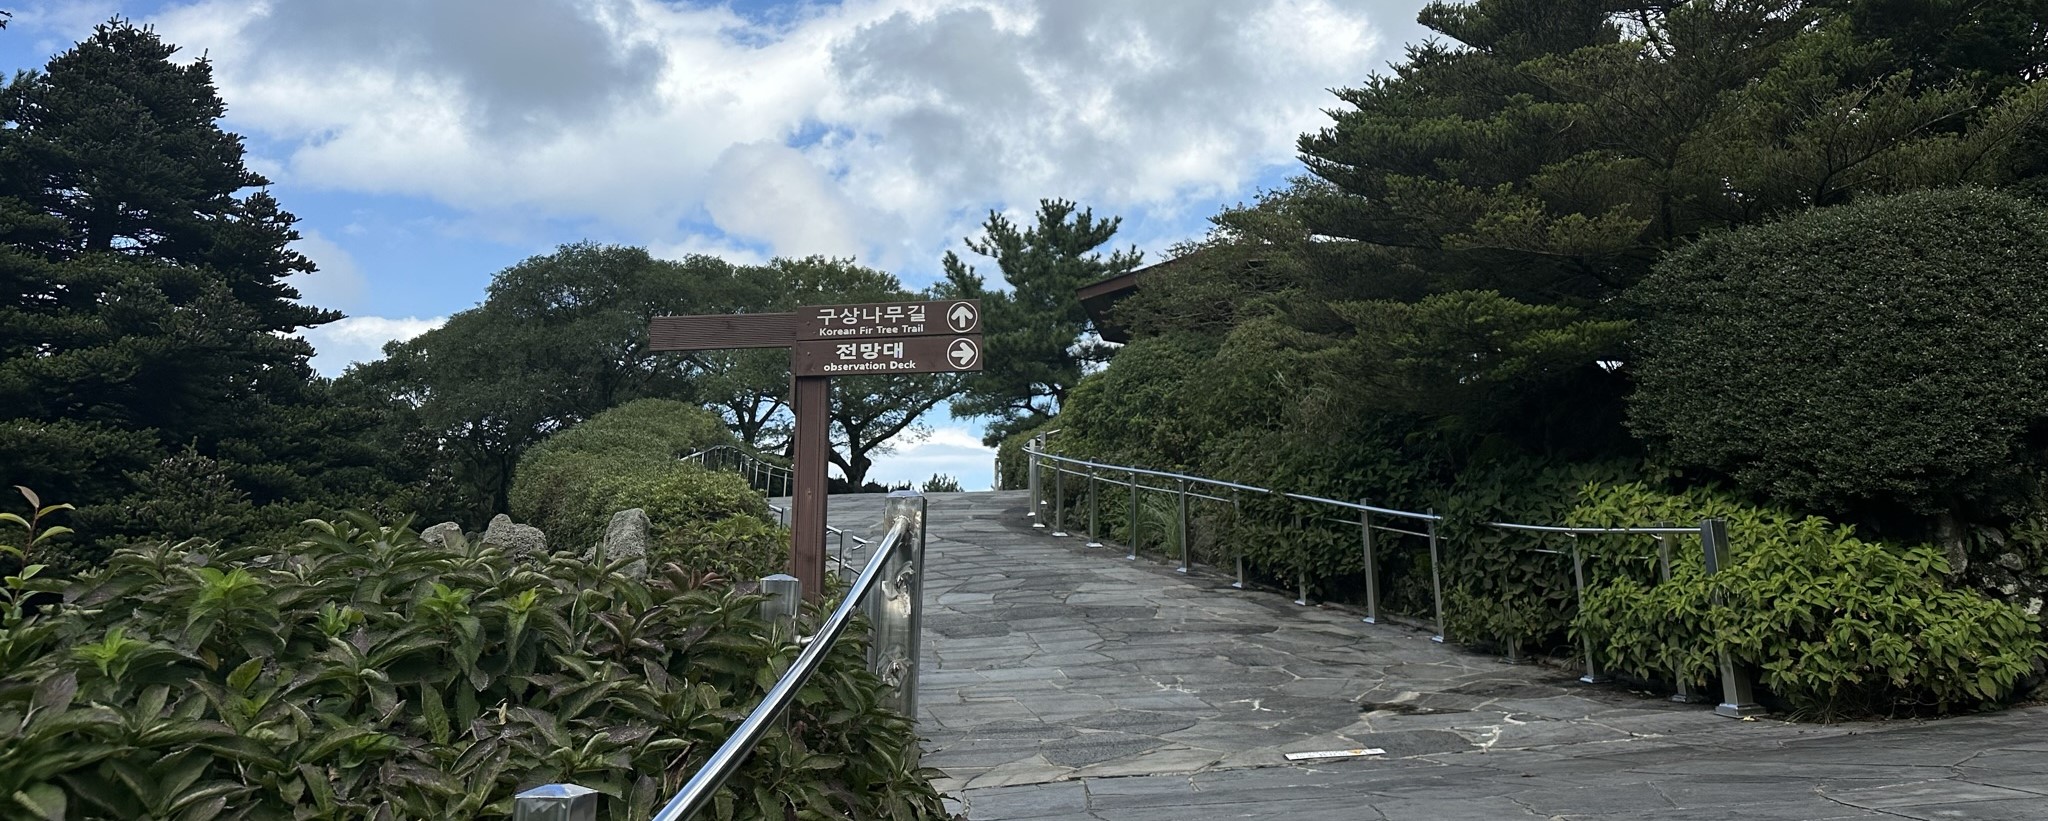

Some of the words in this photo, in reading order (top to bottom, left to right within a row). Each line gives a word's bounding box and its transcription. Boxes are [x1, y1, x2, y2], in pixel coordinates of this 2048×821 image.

[816, 305, 926, 325] 구상나무길
[819, 327, 856, 336] Korean
[859, 326, 874, 334] Fir
[876, 325, 898, 334] Tree
[901, 324, 924, 333] Trail
[835, 342, 904, 360] 전망대
[823, 361, 886, 372] observation
[889, 360, 916, 370] Deck
